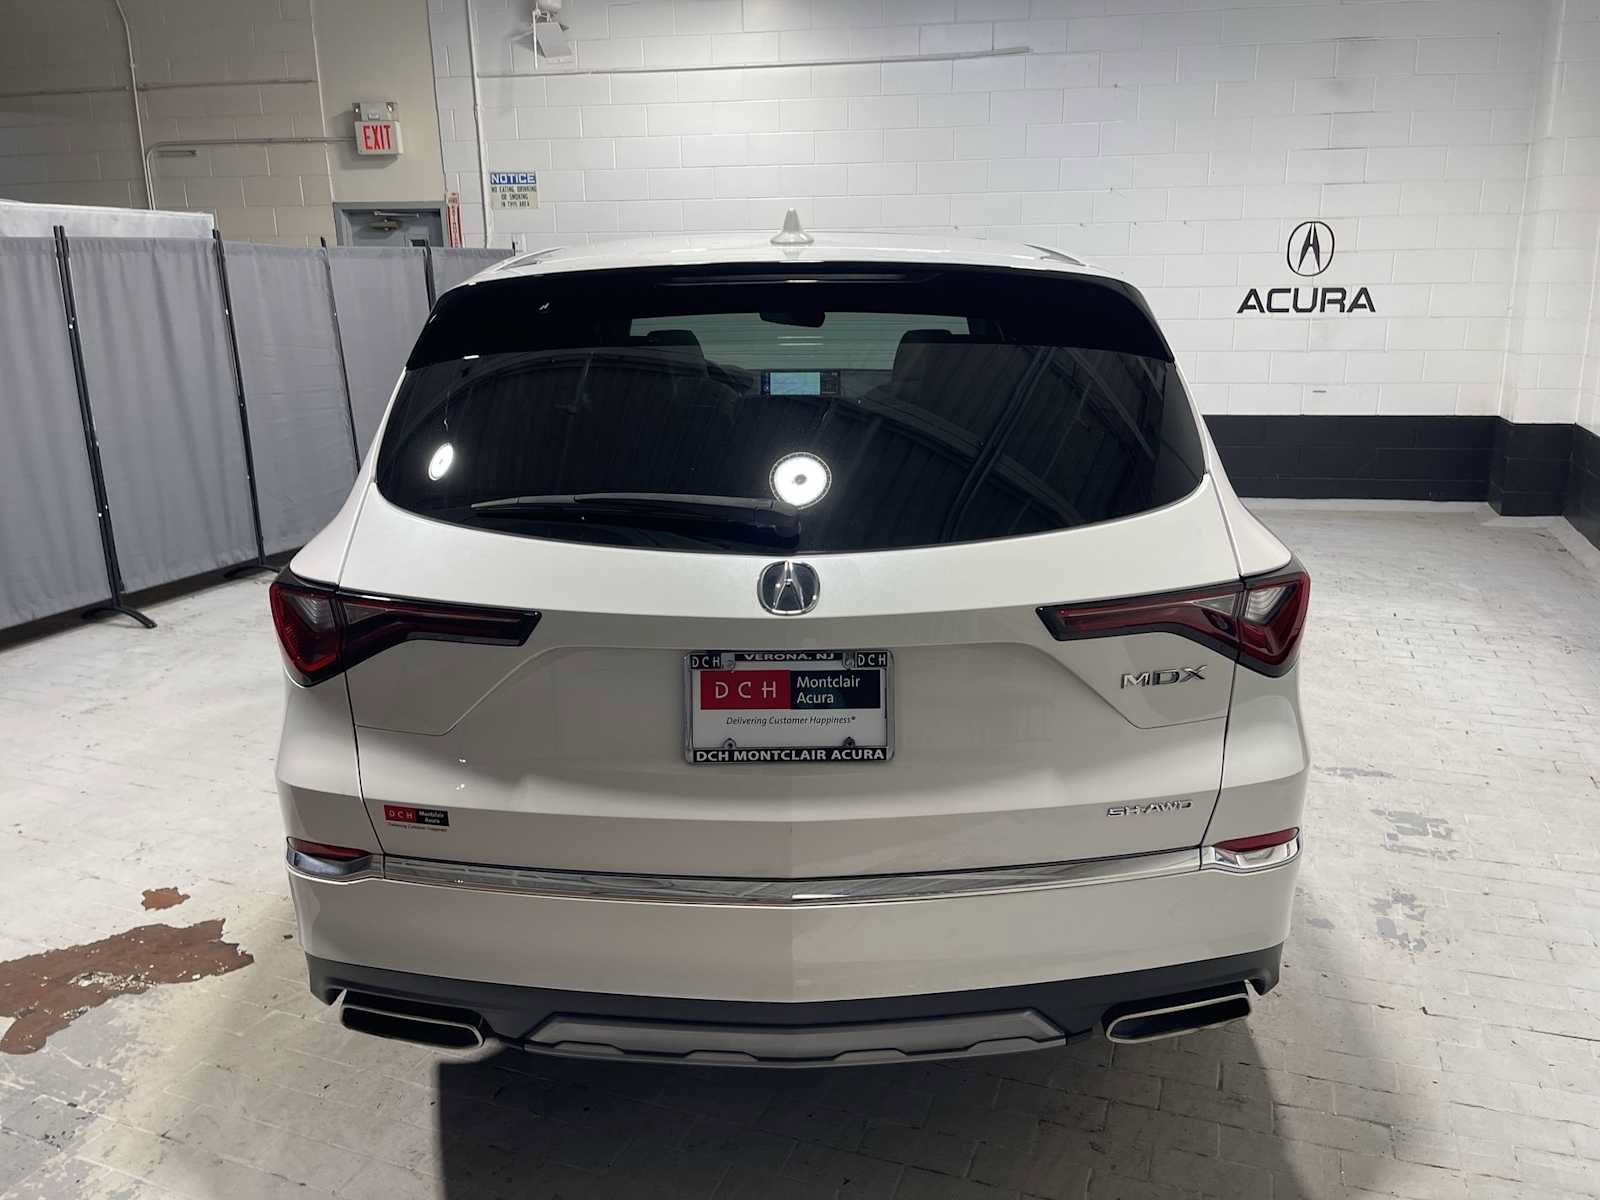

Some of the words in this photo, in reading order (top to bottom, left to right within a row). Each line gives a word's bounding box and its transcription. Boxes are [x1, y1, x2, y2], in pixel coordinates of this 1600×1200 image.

[363, 124, 391, 150] EXIT
[491, 173, 536, 184] NOTICE
[1236, 287, 1376, 313] ACURA
[692, 655, 721, 668] DCH
[744, 652, 812, 661] VERONA,
[815, 652, 835, 661] NJ
[857, 653, 887, 667] DCH
[797, 675, 860, 688] Montclair
[1120, 665, 1208, 689] MDX
[797, 691, 834, 704] Acura
[726, 716, 767, 727] Delivering
[769, 716, 808, 725] Customer
[696, 751, 729, 762] DCH
[733, 750, 826, 761] MONTCLAIR
[831, 749, 885, 760] ACURA
